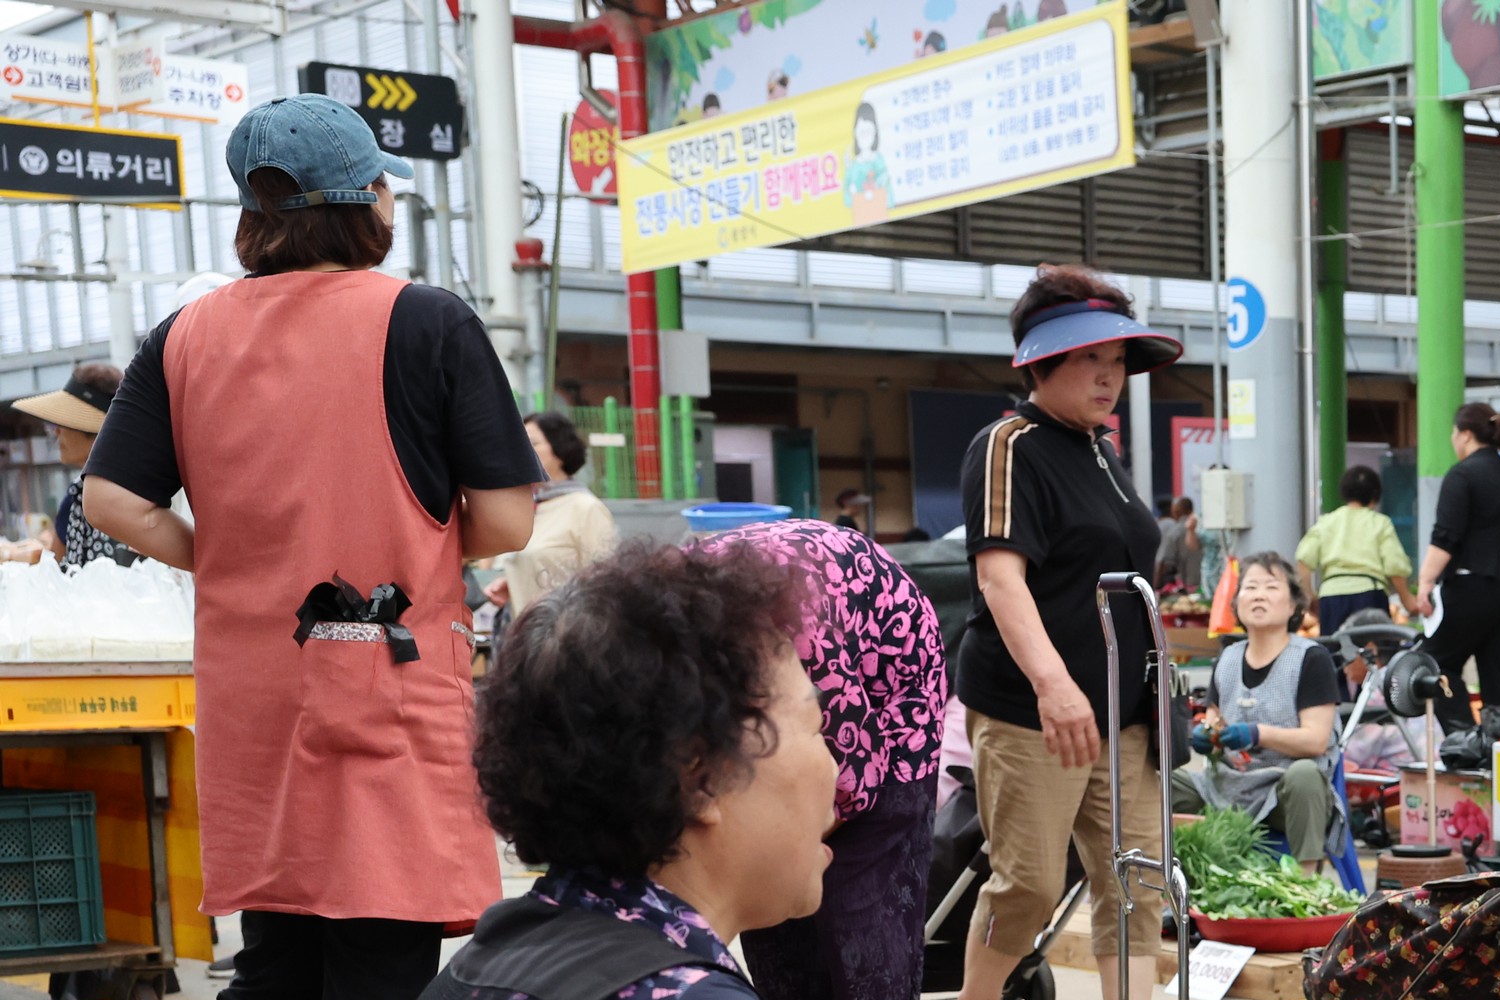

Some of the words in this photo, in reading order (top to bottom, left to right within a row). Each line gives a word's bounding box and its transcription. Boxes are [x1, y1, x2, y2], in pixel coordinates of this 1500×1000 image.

[55, 147, 174, 187] 의류거리
[570, 125, 619, 167] 화장
[668, 130, 737, 181] 안전하고
[741, 113, 796, 163] 편리한
[635, 185, 702, 236] 전통시장
[706, 172, 760, 220] 만들기
[763, 154, 840, 209] 함께해요
